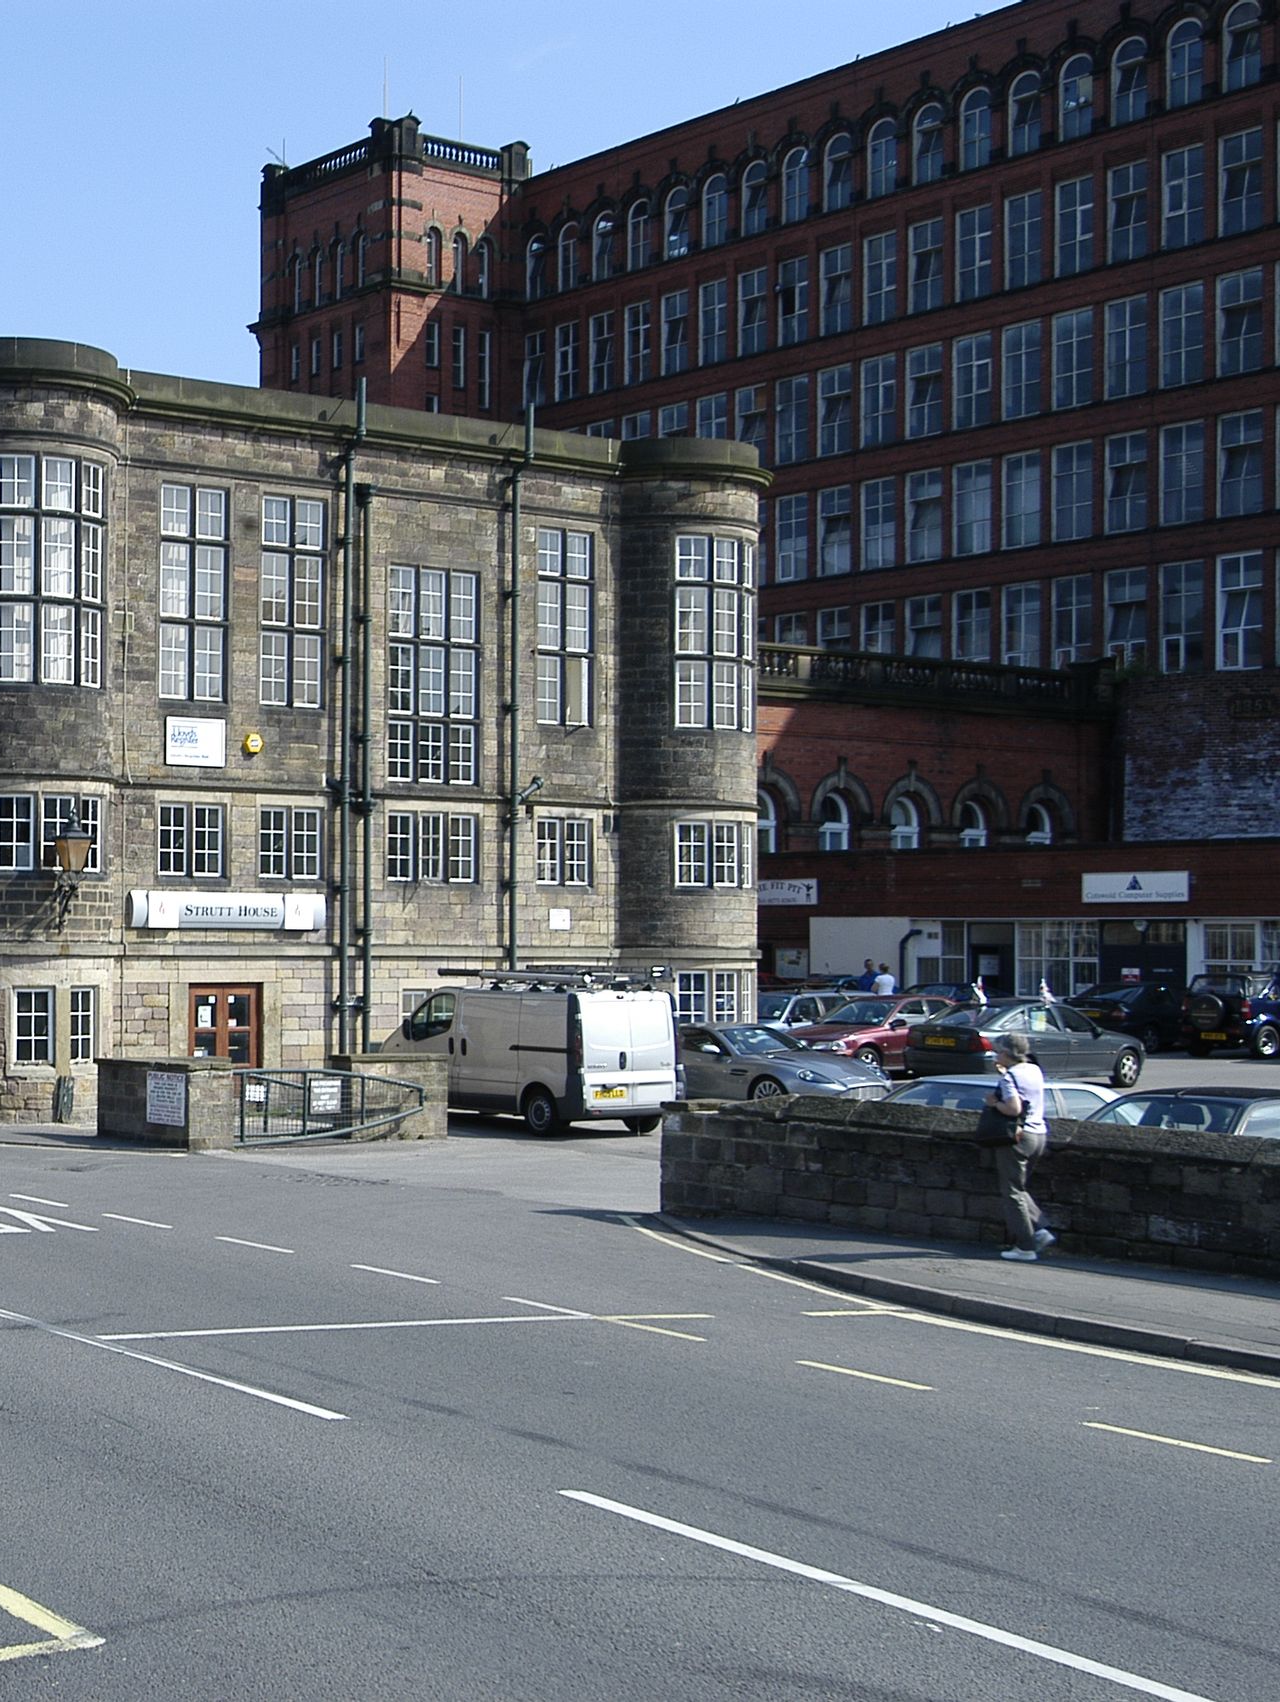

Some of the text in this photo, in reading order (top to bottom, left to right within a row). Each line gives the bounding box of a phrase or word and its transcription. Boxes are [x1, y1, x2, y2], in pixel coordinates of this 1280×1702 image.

[1118, 891, 1153, 899] Computer
[1155, 890, 1185, 899] Supplies
[184, 904, 279, 917] STRUTT HOUSE
